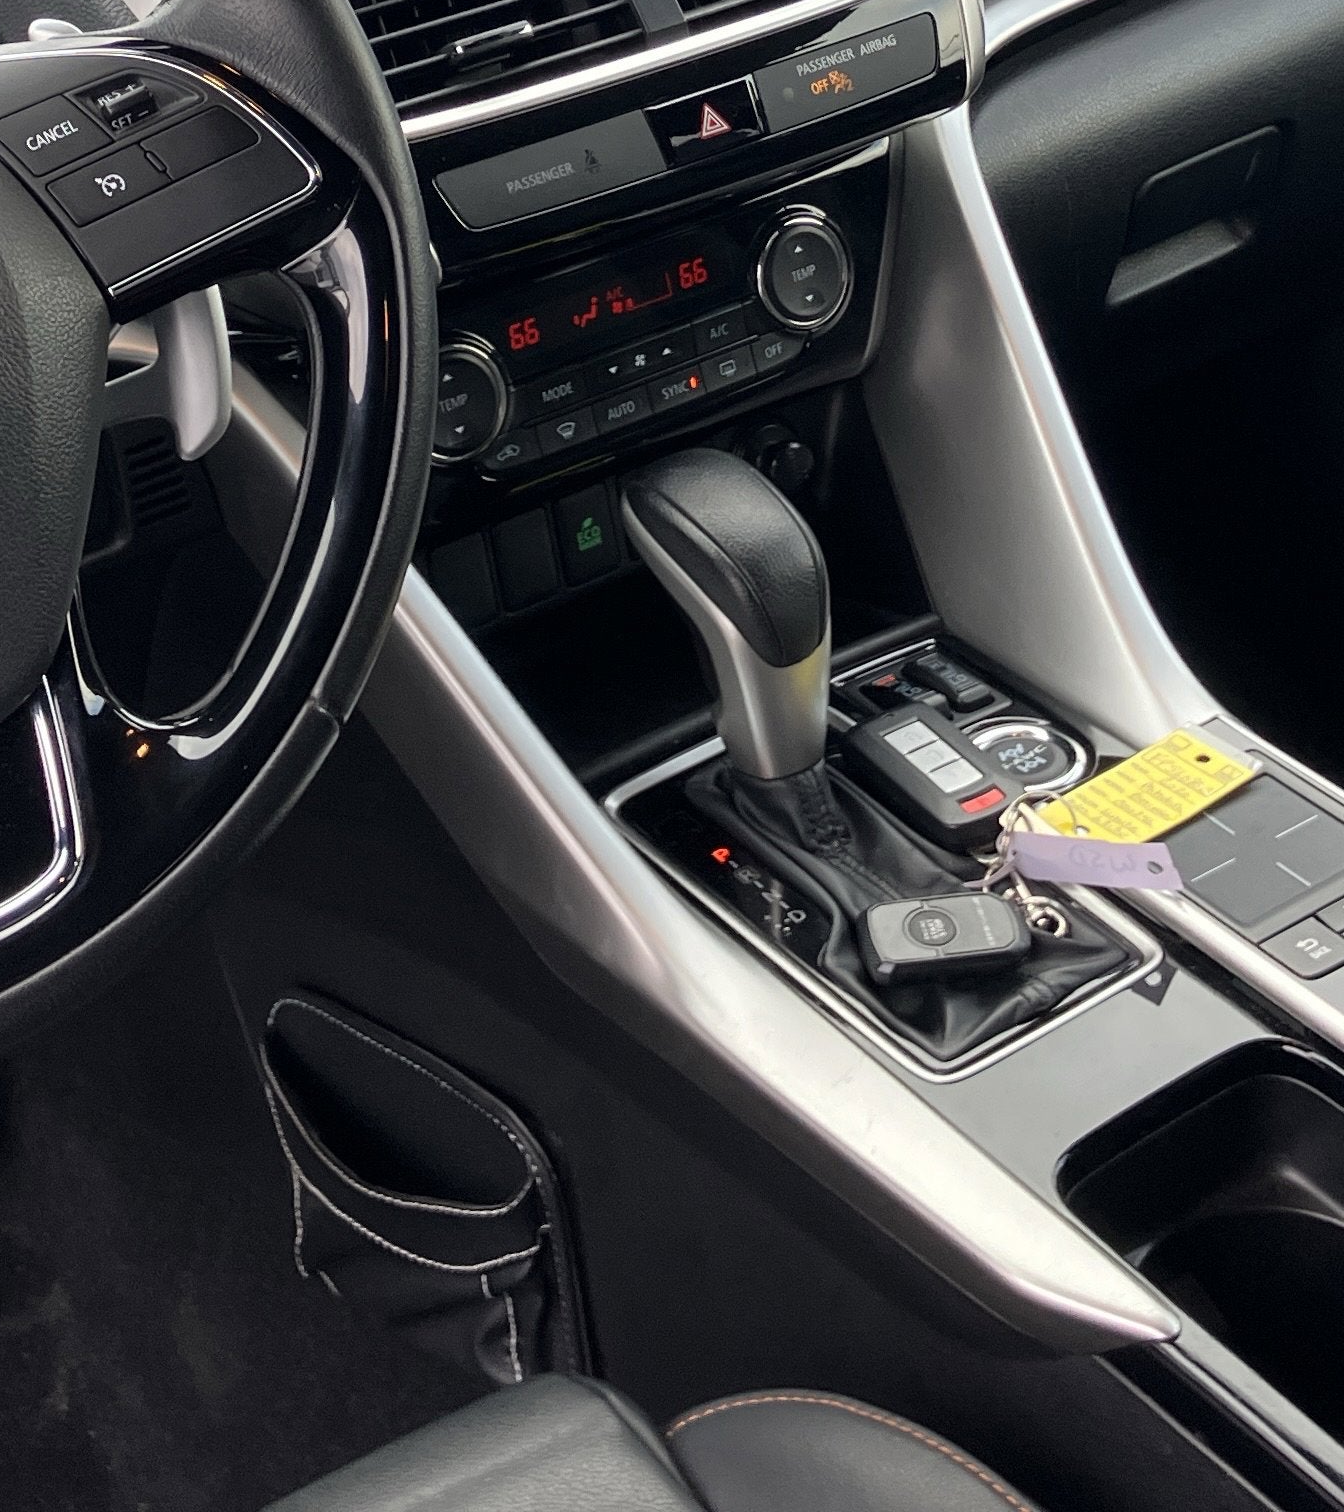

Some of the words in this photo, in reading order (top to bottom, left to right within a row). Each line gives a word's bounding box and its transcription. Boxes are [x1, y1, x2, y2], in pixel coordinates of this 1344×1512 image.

[795, 48, 856, 76] PASSENGER
[860, 34, 897, 56] AIRBAG
[810, 78, 829, 95] OFF
[26, 119, 79, 151] CANCEL
[506, 162, 574, 194] PASSENGER
[678, 257, 709, 289] 66
[790, 265, 817, 283] TEMP
[507, 316, 540, 350] 66
[709, 323, 729, 339] A/C
[764, 342, 784, 359] OFF
[541, 382, 574, 403] MODE
[661, 382, 690, 400] SYNC
[438, 393, 469, 413] TEMP
[607, 401, 636, 421] AUTO
[711, 848, 731, 863] P
